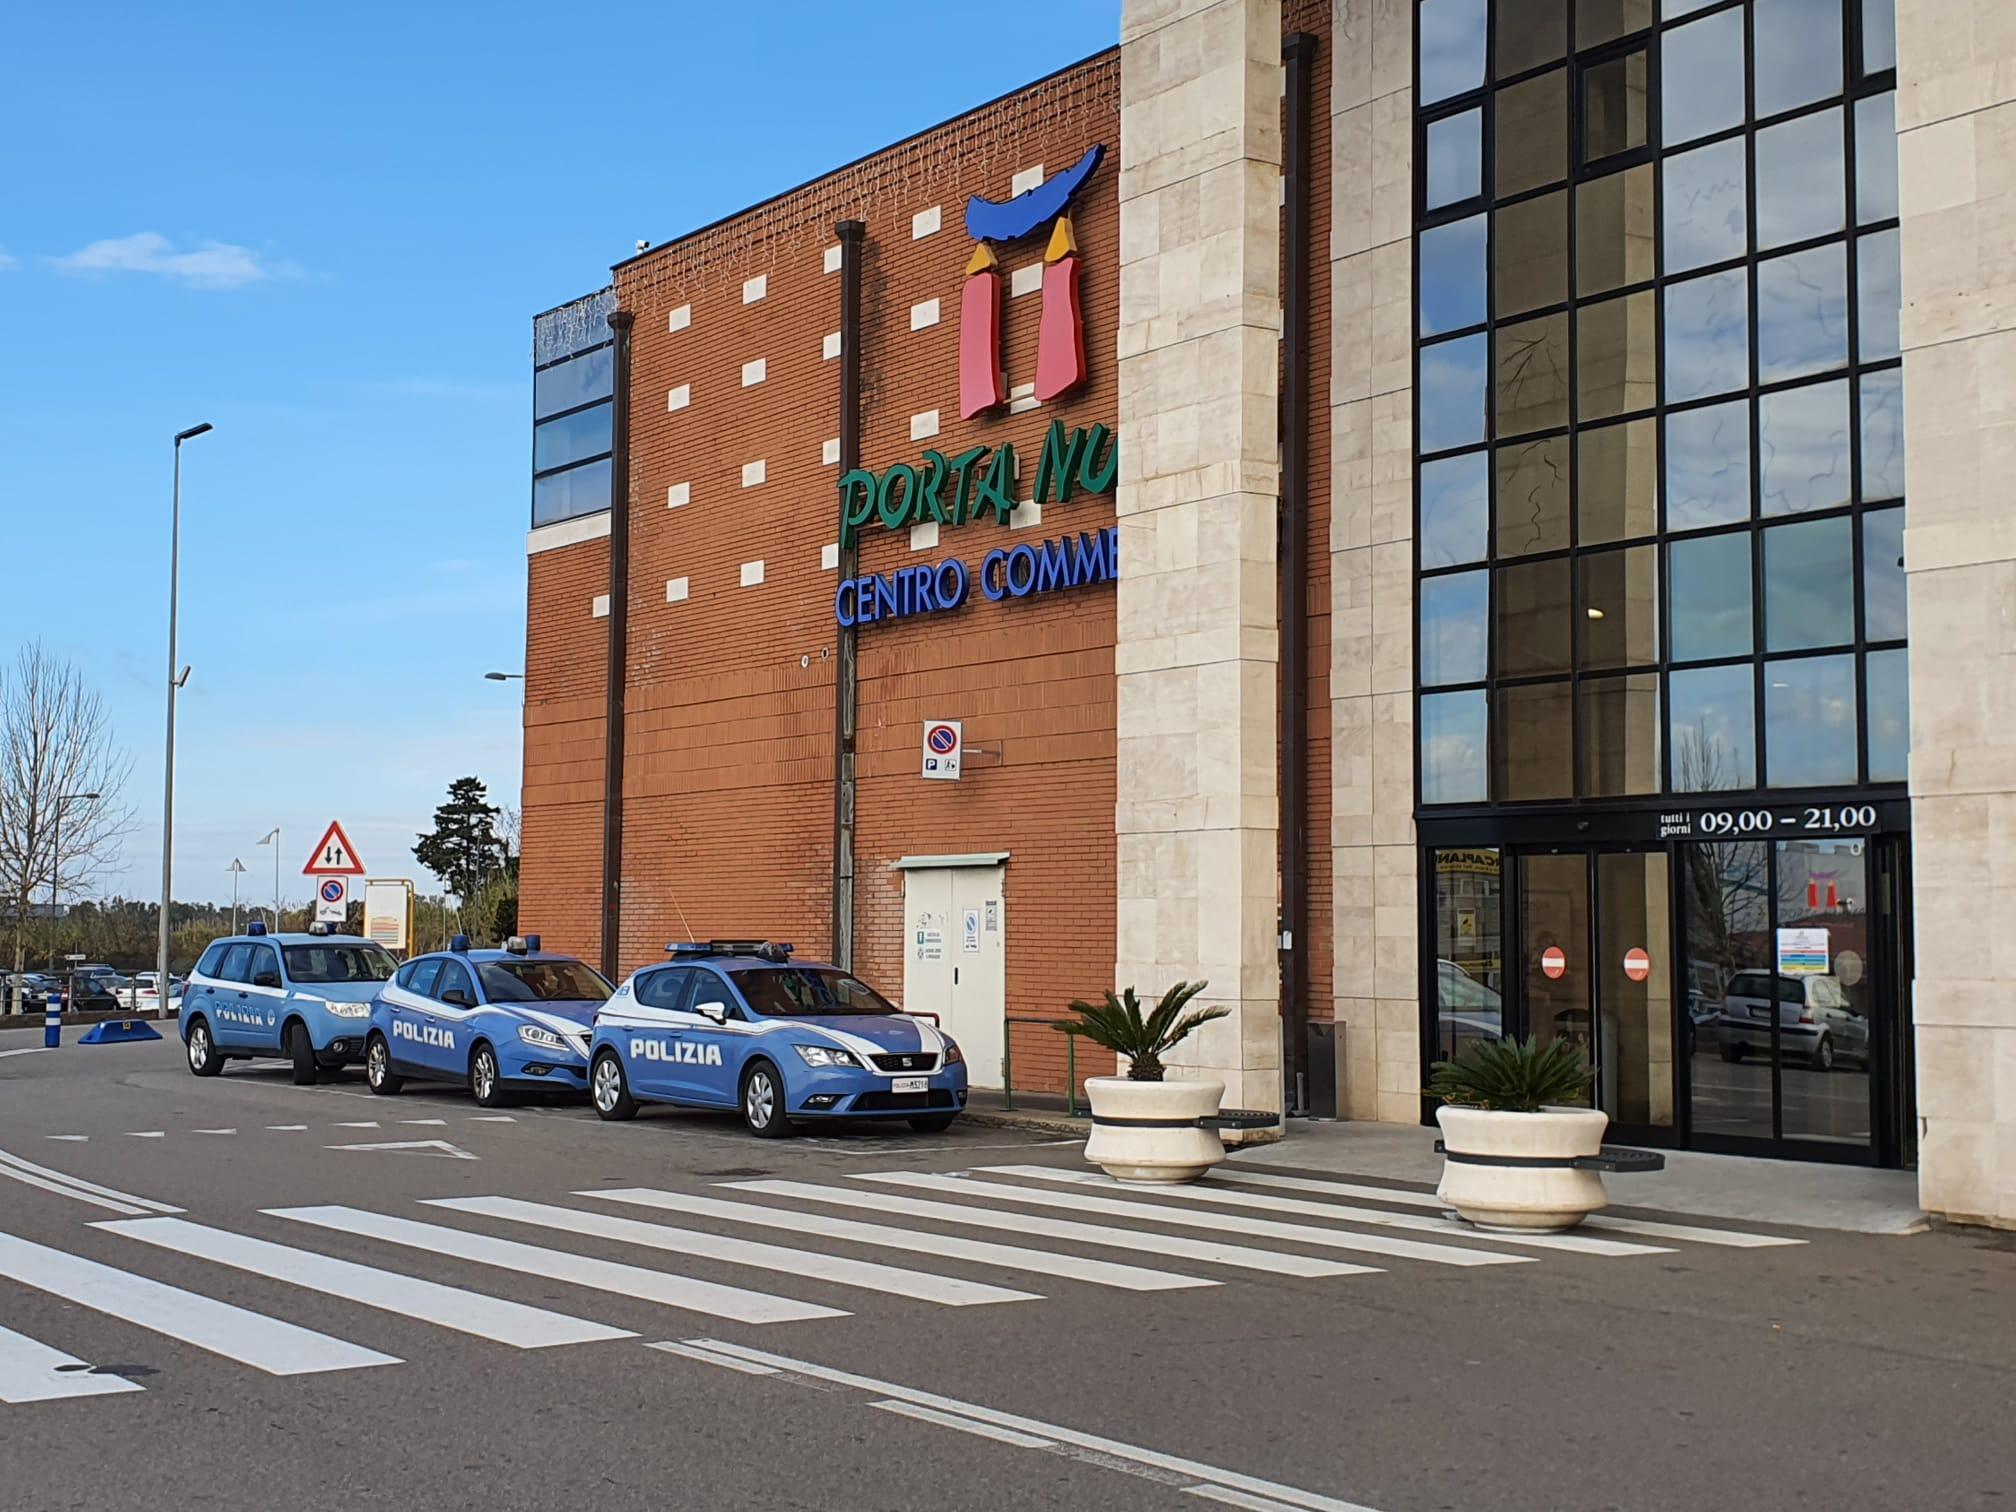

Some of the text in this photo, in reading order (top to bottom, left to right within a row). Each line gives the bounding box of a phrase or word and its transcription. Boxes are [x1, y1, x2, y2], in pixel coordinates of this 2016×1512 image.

[837, 442, 1019, 550] PORTA
[835, 557, 970, 628] CENTRO
[1660, 813, 1683, 824] tutti
[1660, 823, 1691, 838] giorni
[1700, 810, 1773, 835] 09,00
[1804, 805, 1876, 832] 21,00
[214, 1000, 264, 1027] POLIZIA
[392, 1019, 456, 1050] POLIZIA
[630, 1038, 723, 1066] POLIZIA
